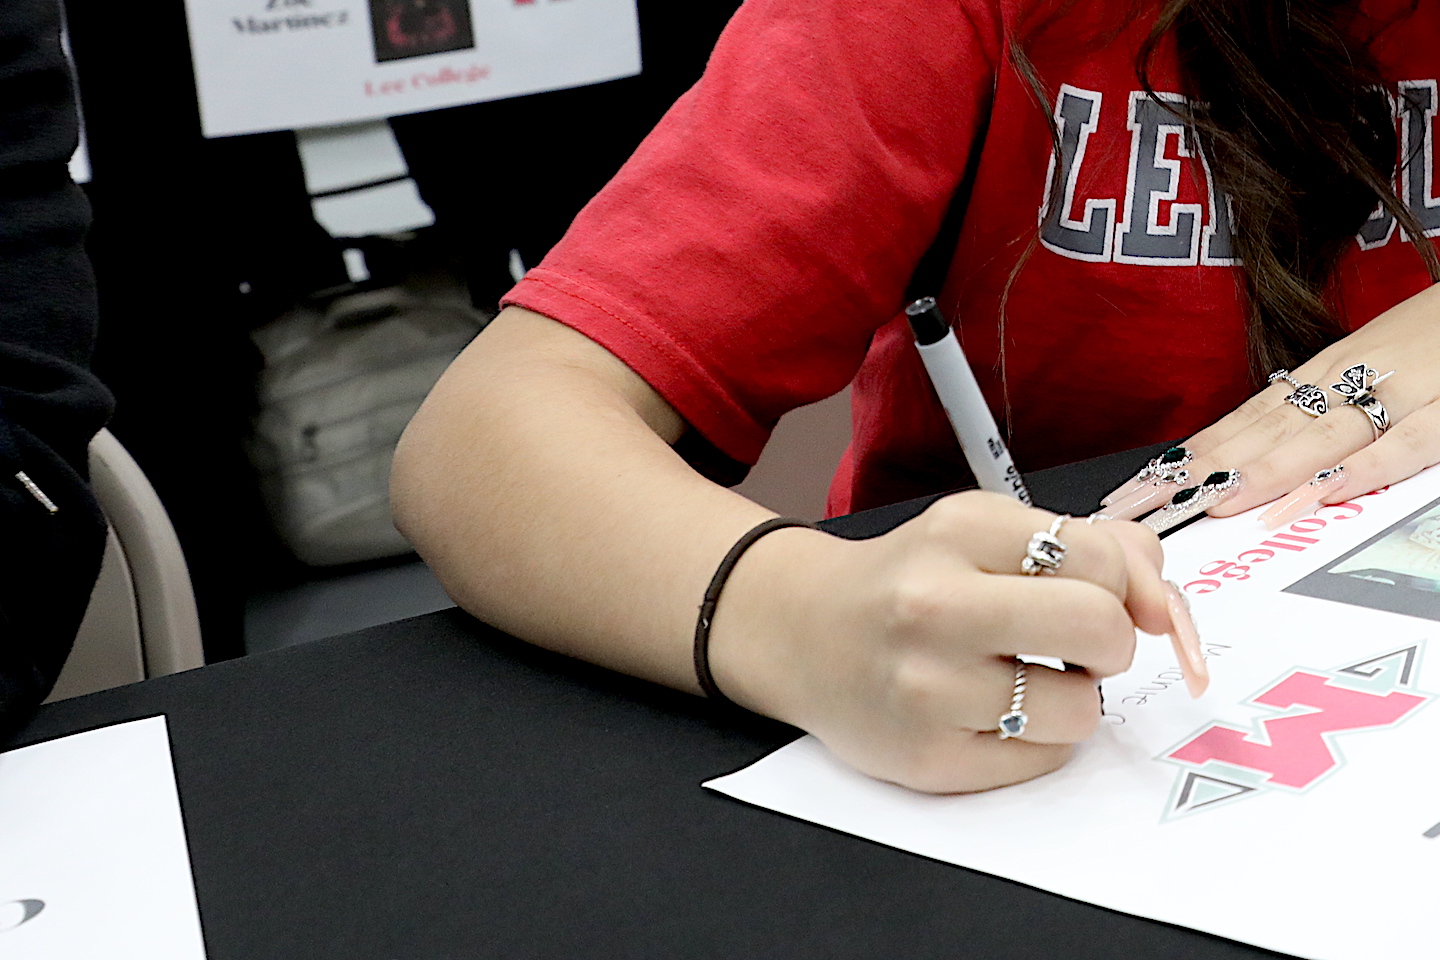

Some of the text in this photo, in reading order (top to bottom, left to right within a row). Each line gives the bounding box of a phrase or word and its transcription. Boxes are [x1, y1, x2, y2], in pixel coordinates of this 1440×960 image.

[363, 63, 494, 98] Lee College
[1182, 501, 1364, 595] College
[1165, 669, 1431, 790] M
